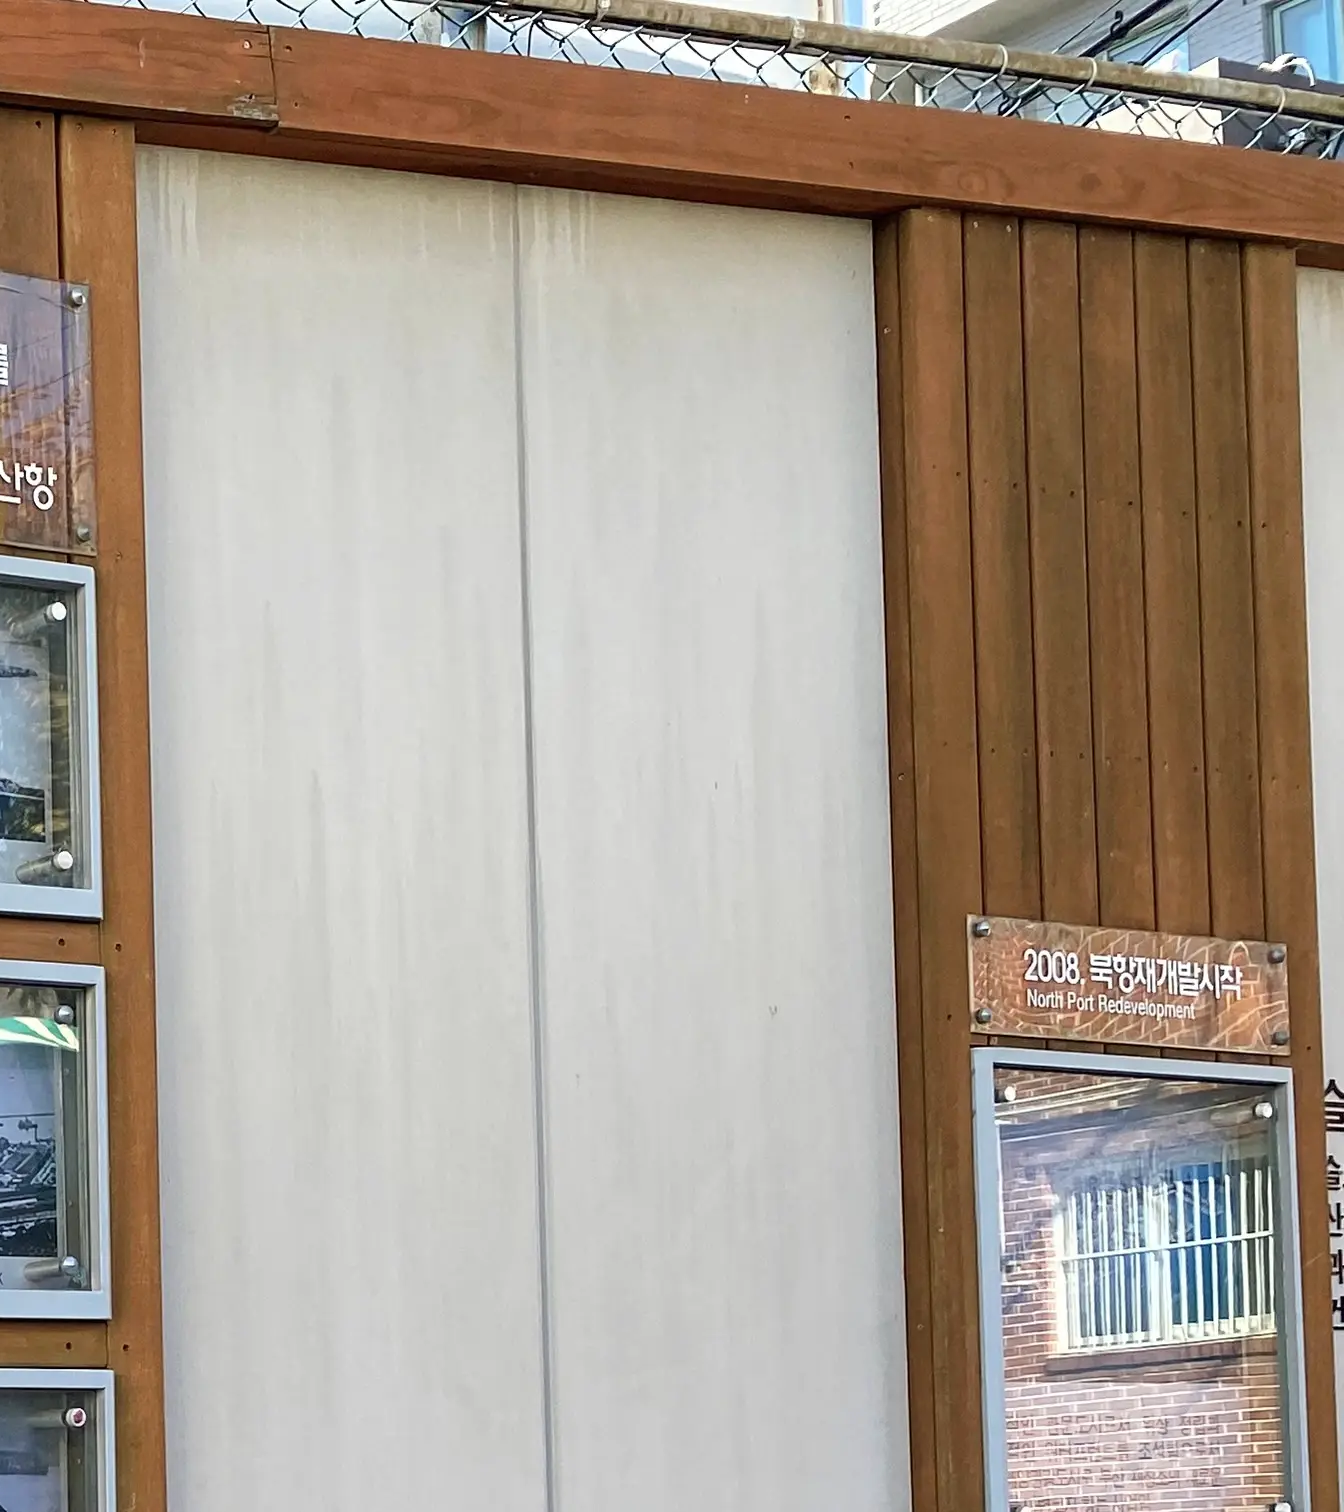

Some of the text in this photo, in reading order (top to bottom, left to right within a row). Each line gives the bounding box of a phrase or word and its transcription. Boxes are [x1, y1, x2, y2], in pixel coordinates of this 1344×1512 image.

[1022, 947, 1243, 1001] 2008. 북항재개발시작
[1026, 988, 1196, 1020] North Port Redevelopment
